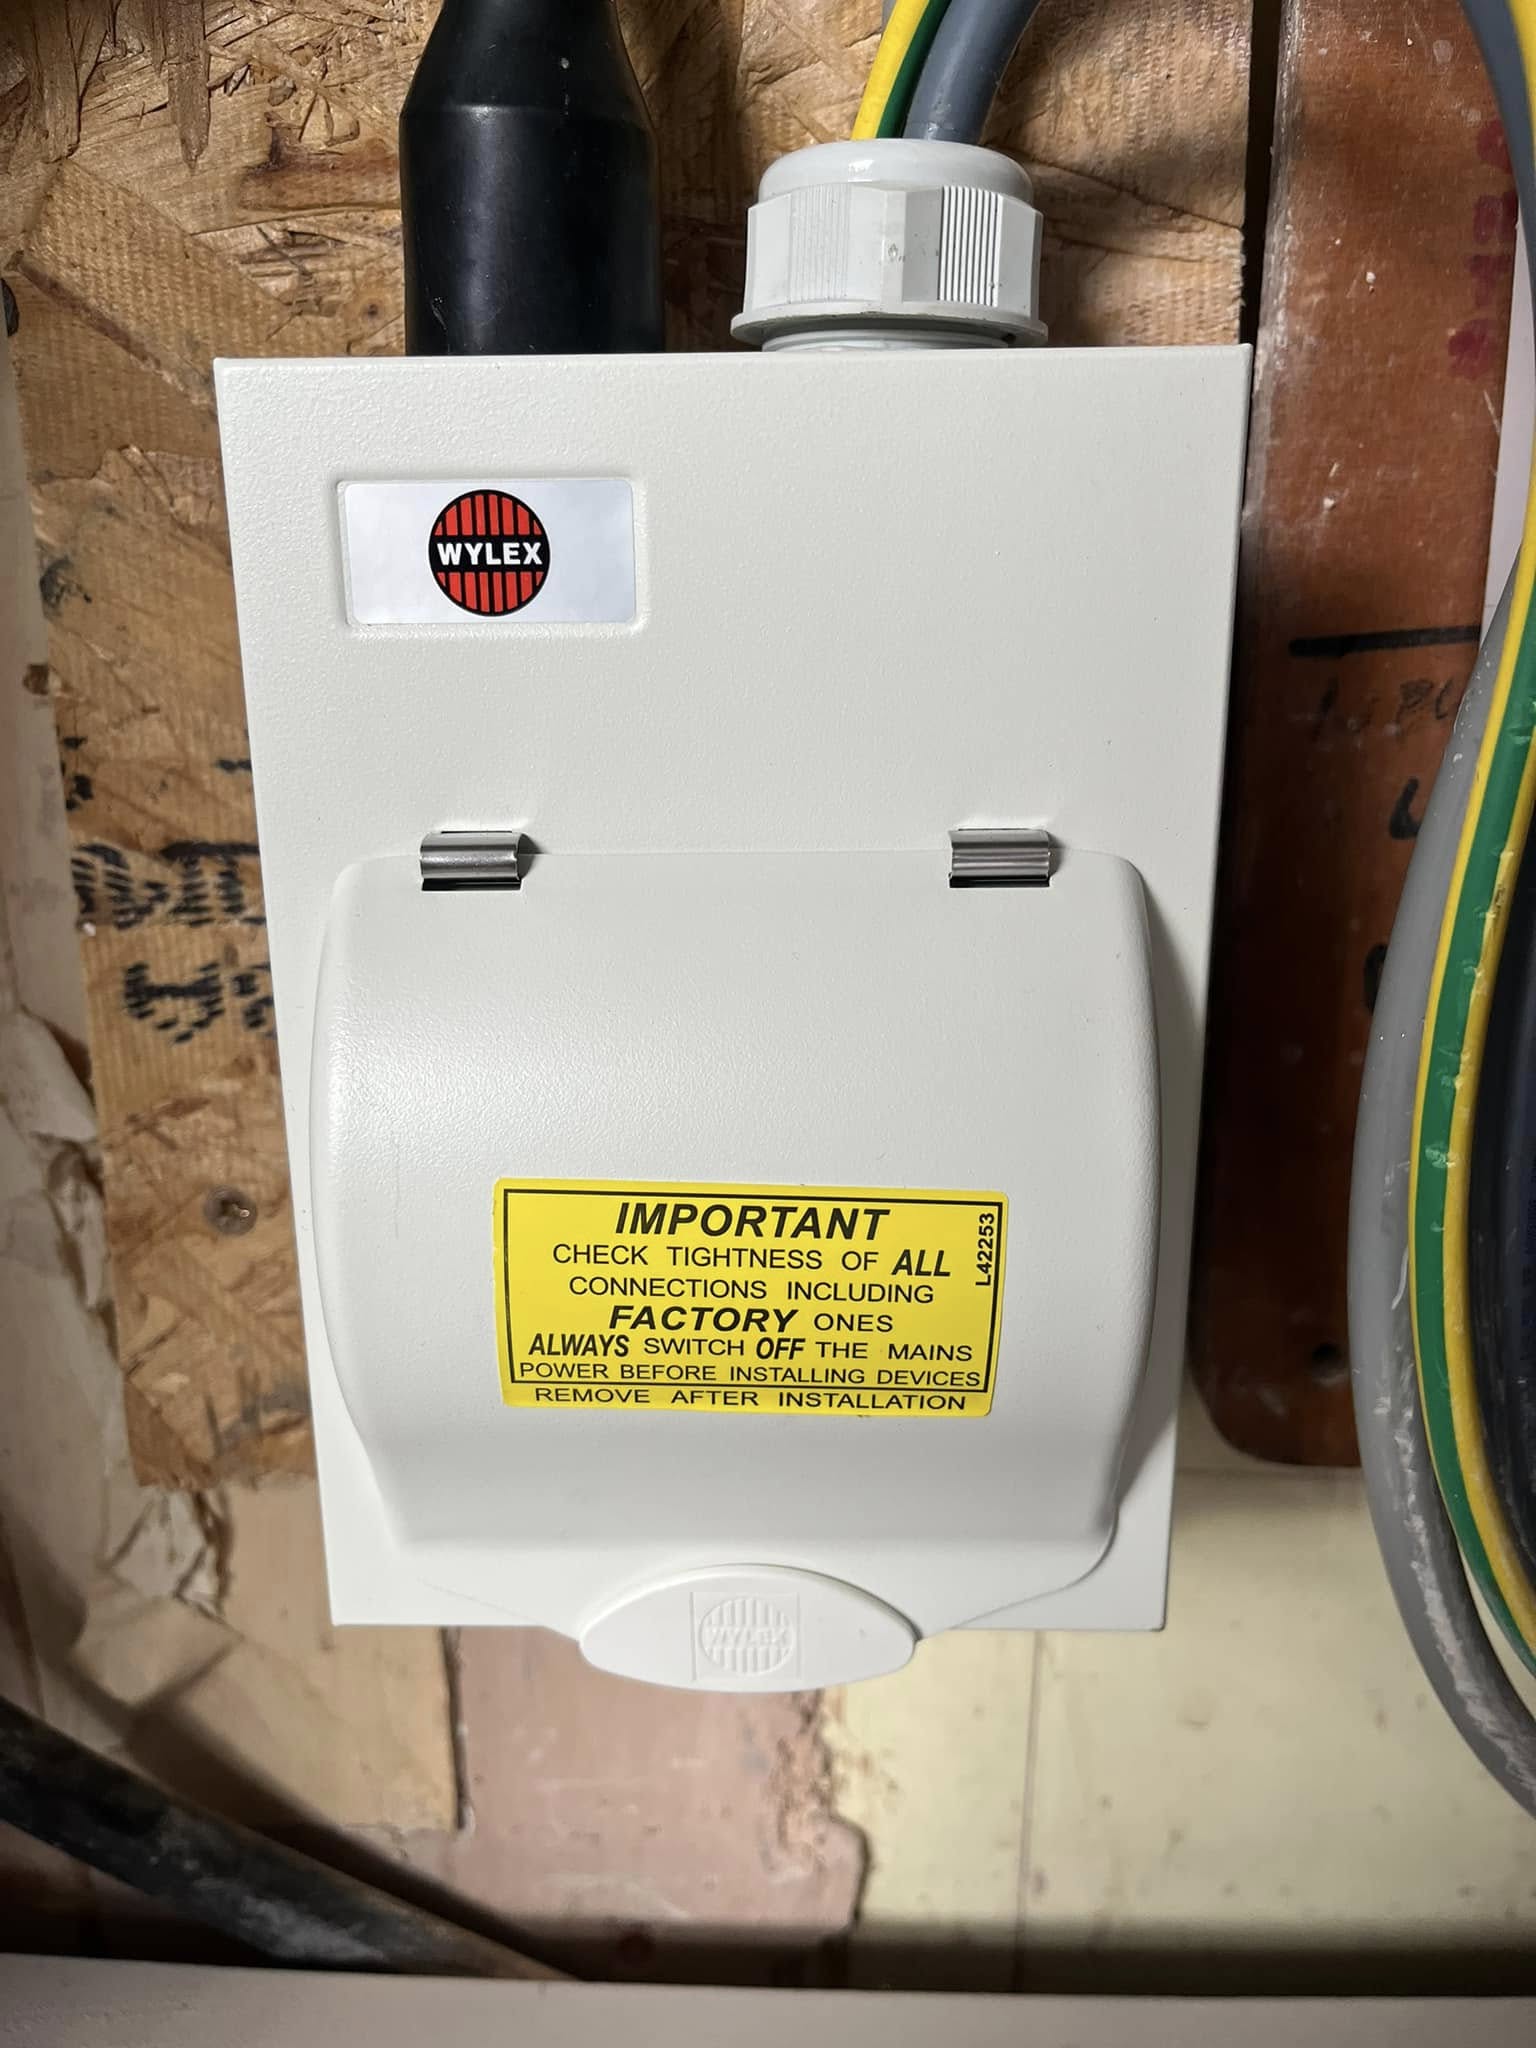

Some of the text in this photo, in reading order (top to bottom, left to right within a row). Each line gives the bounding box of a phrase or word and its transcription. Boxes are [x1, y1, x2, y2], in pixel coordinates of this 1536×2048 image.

[436, 541, 543, 566] WYLEX
[615, 1202, 890, 1241] IMPORTANT
[553, 1243, 951, 1277] CHECK TIGHTNESS OF ALL
[975, 1212, 996, 1287] L42253
[569, 1276, 934, 1304] CONNECTIONS INCLUDING
[608, 1305, 893, 1333] FACTORY ONES
[528, 1332, 973, 1362] ALWAYS SWITCH OFF THE MAINS
[519, 1362, 981, 1387] POWER BEFORE INSTALLING DEVICES
[535, 1387, 966, 1411] REMOVE AFTER INSTALLATION
